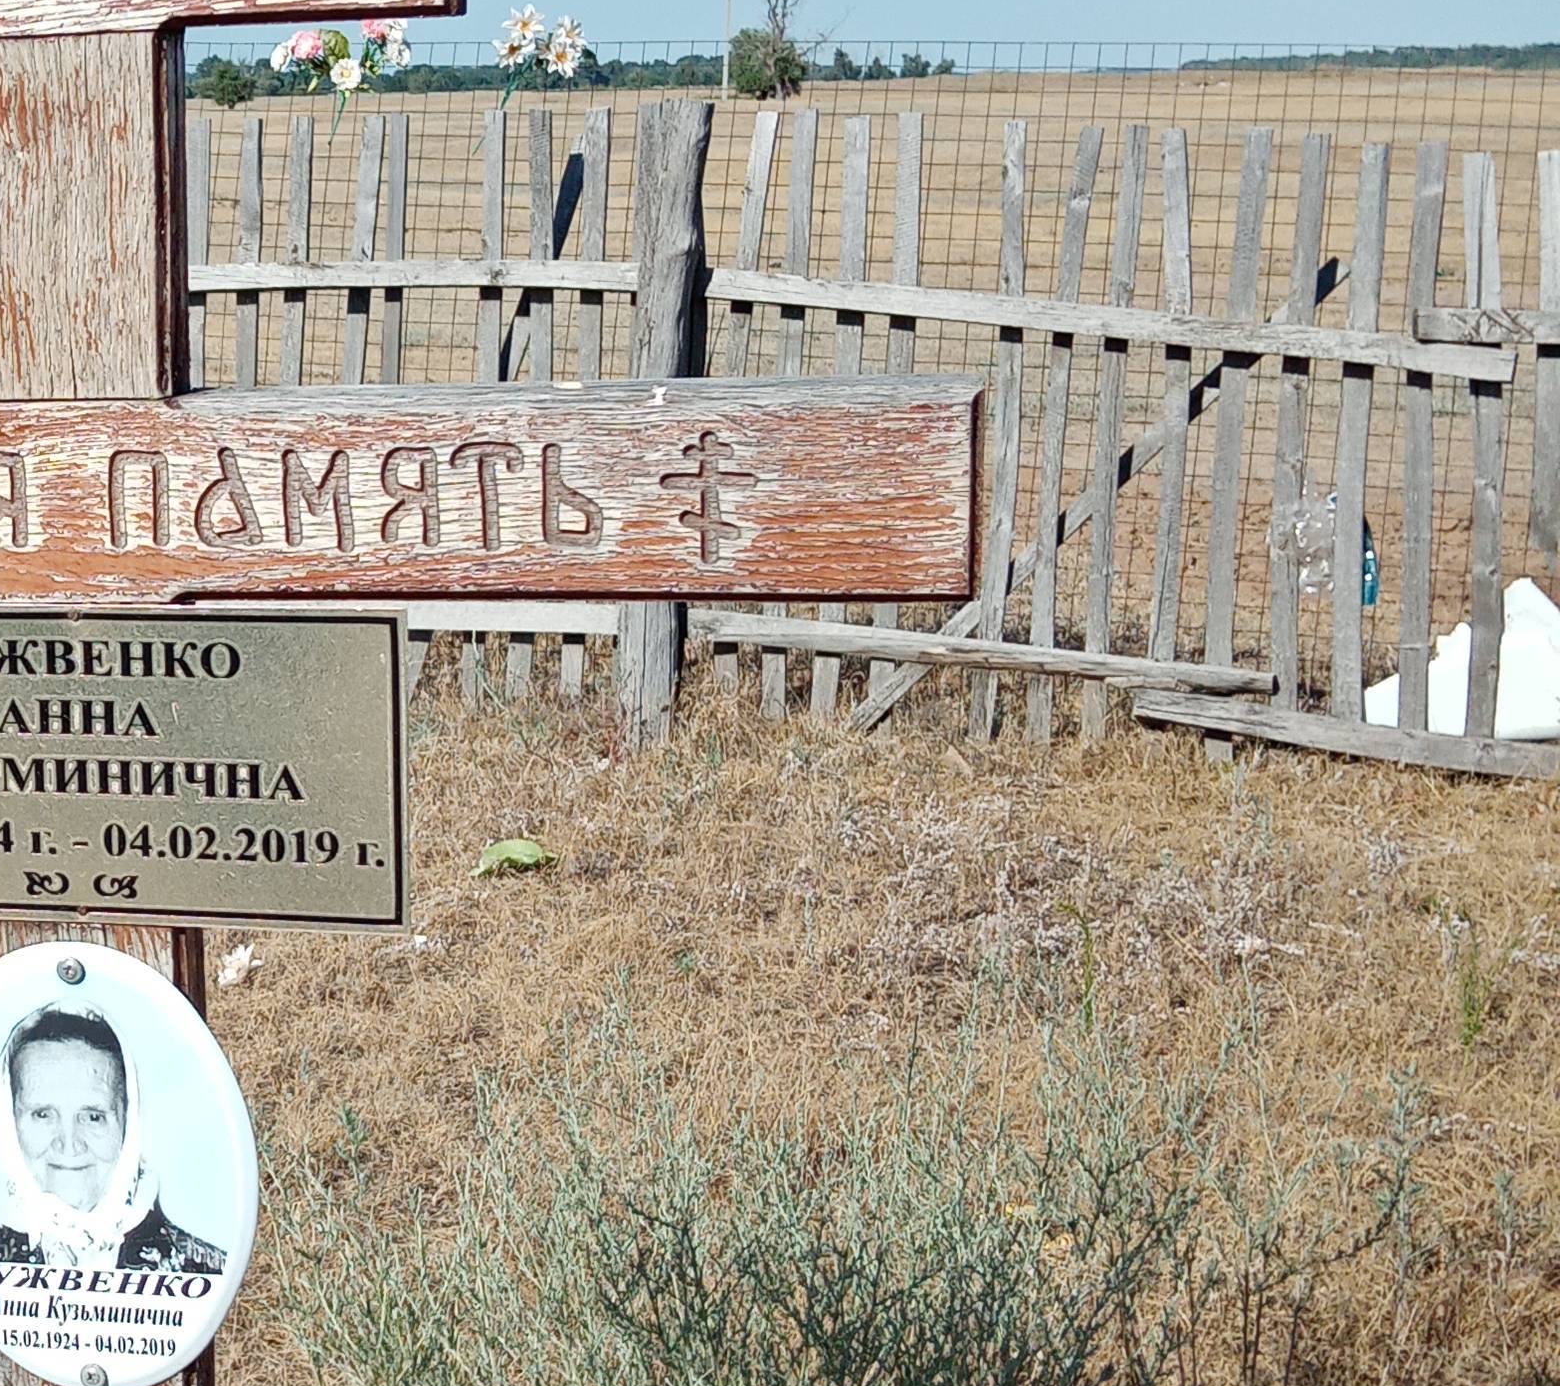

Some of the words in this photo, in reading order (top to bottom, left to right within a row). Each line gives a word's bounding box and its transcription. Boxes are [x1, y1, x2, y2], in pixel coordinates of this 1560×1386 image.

[30, 831, 58, 854] г.
[103, 824, 340, 865] 04.02.2019
[354, 842, 386, 867] г.
[46, 1295, 183, 1328] Кузьминична
[2, 1329, 80, 1351] 15.02.1924
[95, 1335, 176, 1357] 04.02.2019
